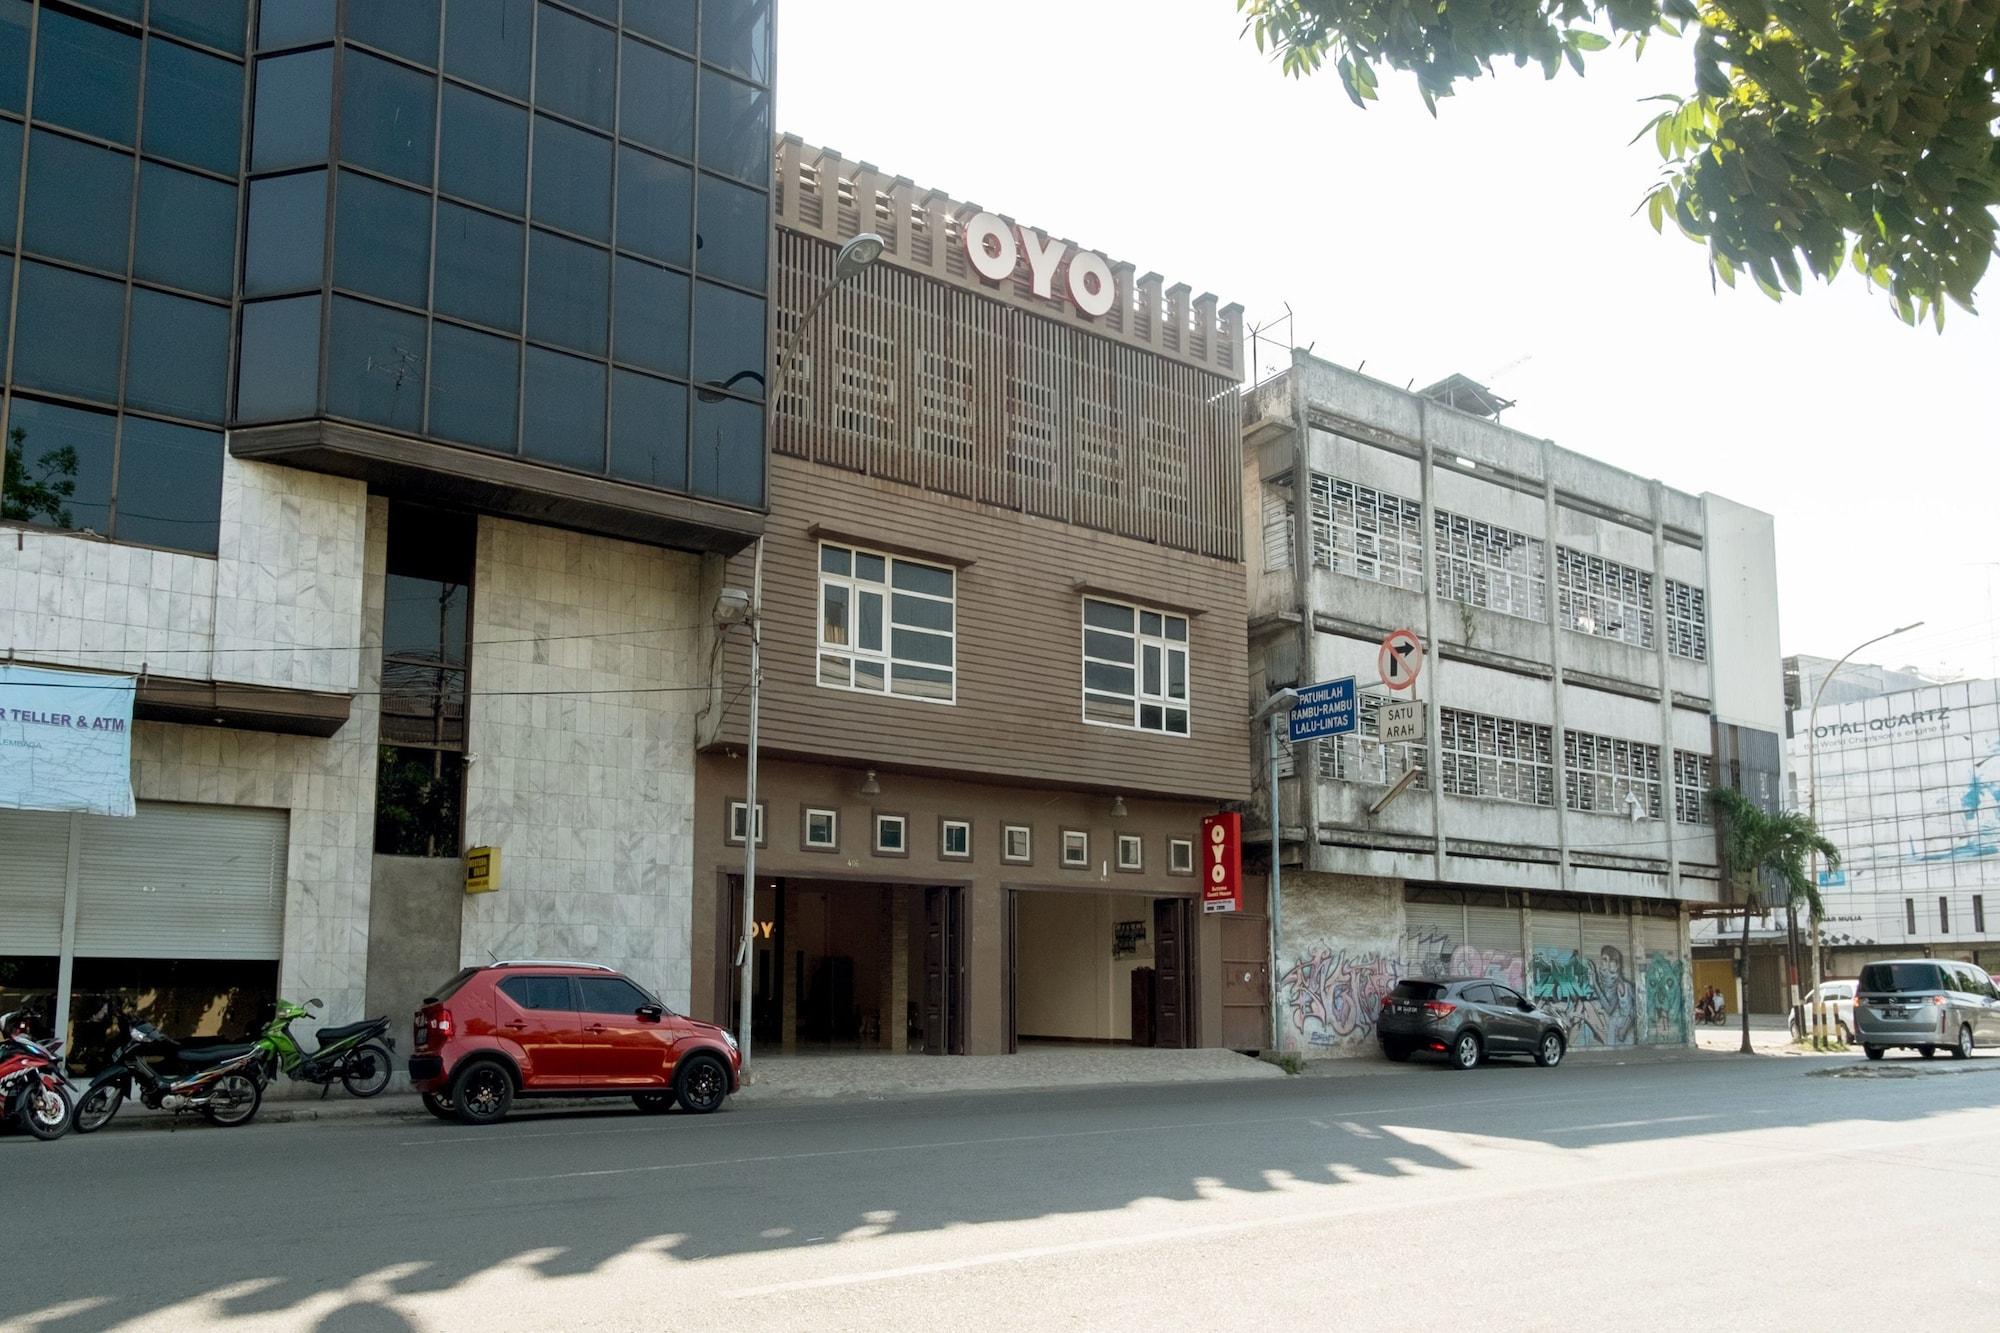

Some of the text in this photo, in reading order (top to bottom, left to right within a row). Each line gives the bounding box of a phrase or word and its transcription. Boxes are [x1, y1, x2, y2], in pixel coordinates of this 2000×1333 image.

[964, 211, 1116, 317] OYO
[1299, 686, 1343, 705] PATUHILAH
[10, 708, 72, 728] TELLER
[76, 716, 89, 729] &
[92, 716, 124, 733] ATM
[1291, 699, 1353, 721] RAMBU-RAMBU
[1388, 707, 1413, 721] SATU
[1869, 707, 1950, 731] QUARTZ
[1295, 714, 1349, 735] LALU-LINTAS
[1386, 725, 1415, 739] ARAH
[0, 738, 42, 749] EMBAGA
[1211, 824, 1225, 883] OYO
